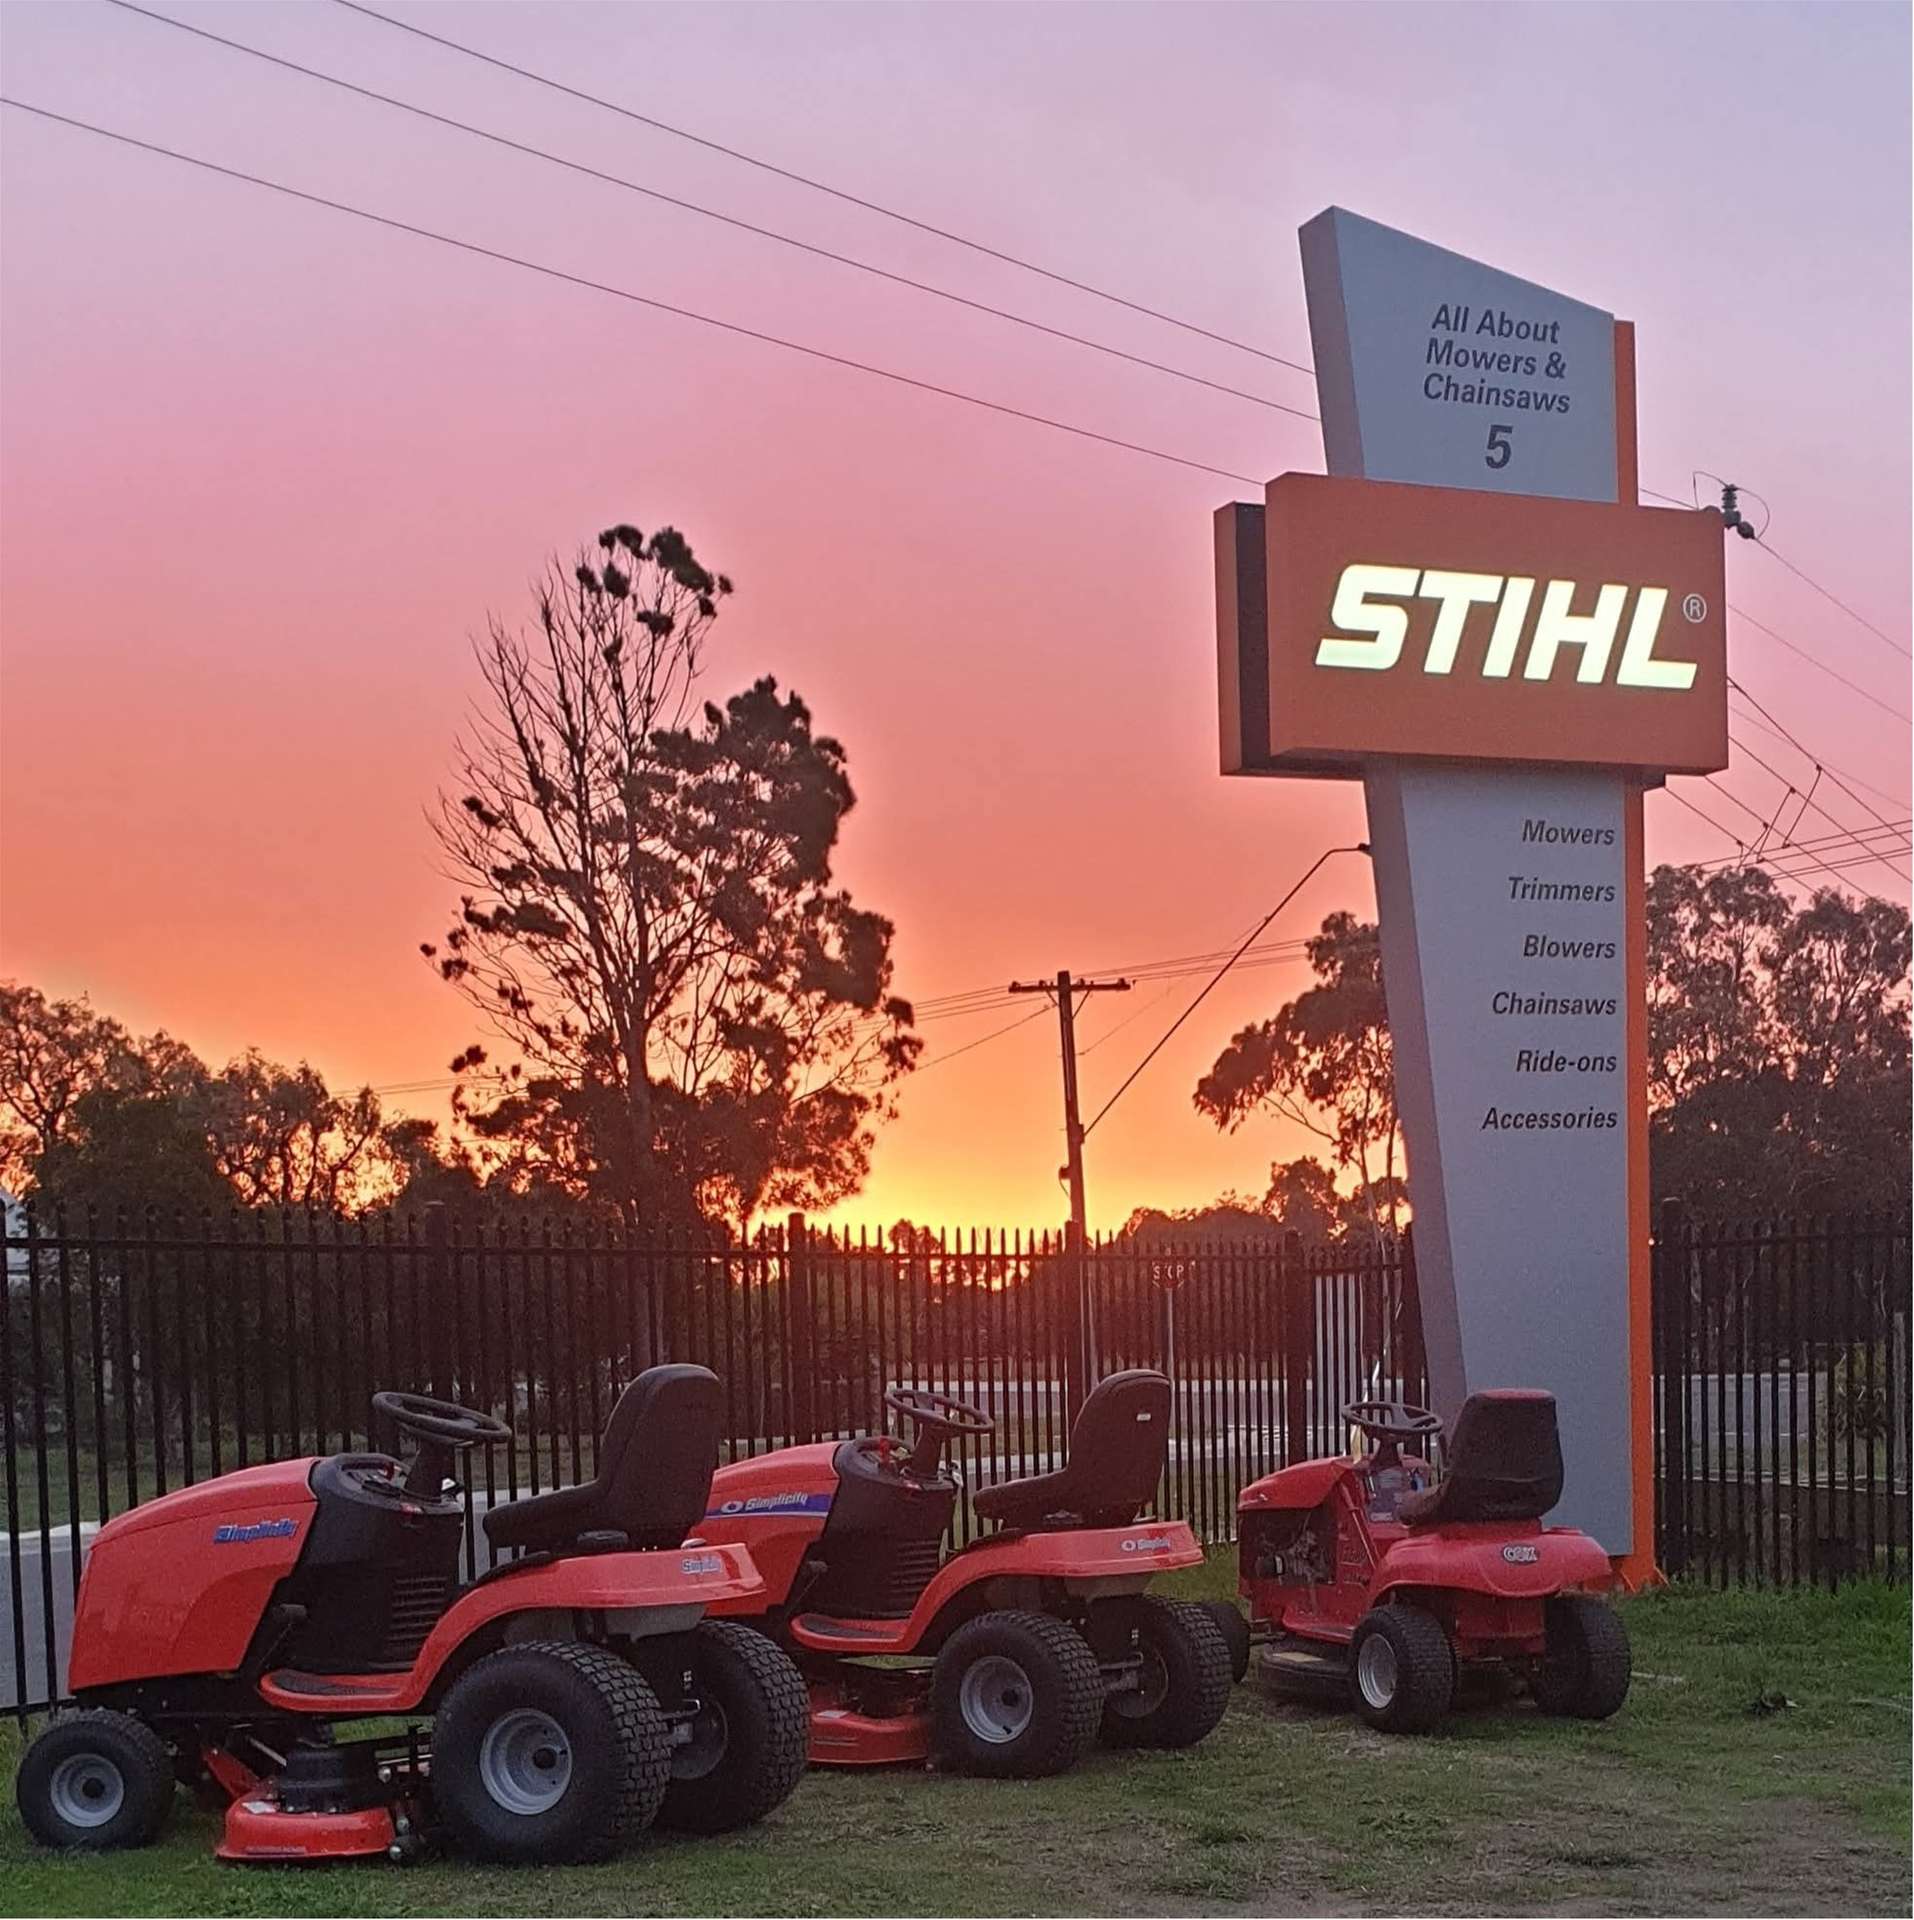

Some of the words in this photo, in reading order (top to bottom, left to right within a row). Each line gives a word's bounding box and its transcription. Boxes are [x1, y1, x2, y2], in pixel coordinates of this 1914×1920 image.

[1432, 304, 1469, 333] All
[1476, 309, 1560, 344] About
[1426, 337, 1537, 376] Mowers
[1545, 351, 1567, 379] &
[1424, 373, 1570, 414] Chainsaws
[1485, 424, 1513, 469] 5
[1315, 564, 1698, 689] STIHL
[1522, 819, 1615, 846] Mowers
[1508, 877, 1616, 902] Trimmers
[1523, 935, 1616, 959] Blowers
[1492, 992, 1617, 1016] Chainsaws
[1516, 1050, 1617, 1073] Ride-ons
[1482, 1107, 1618, 1131] Accessories
[1153, 1264, 1184, 1279] SOP
